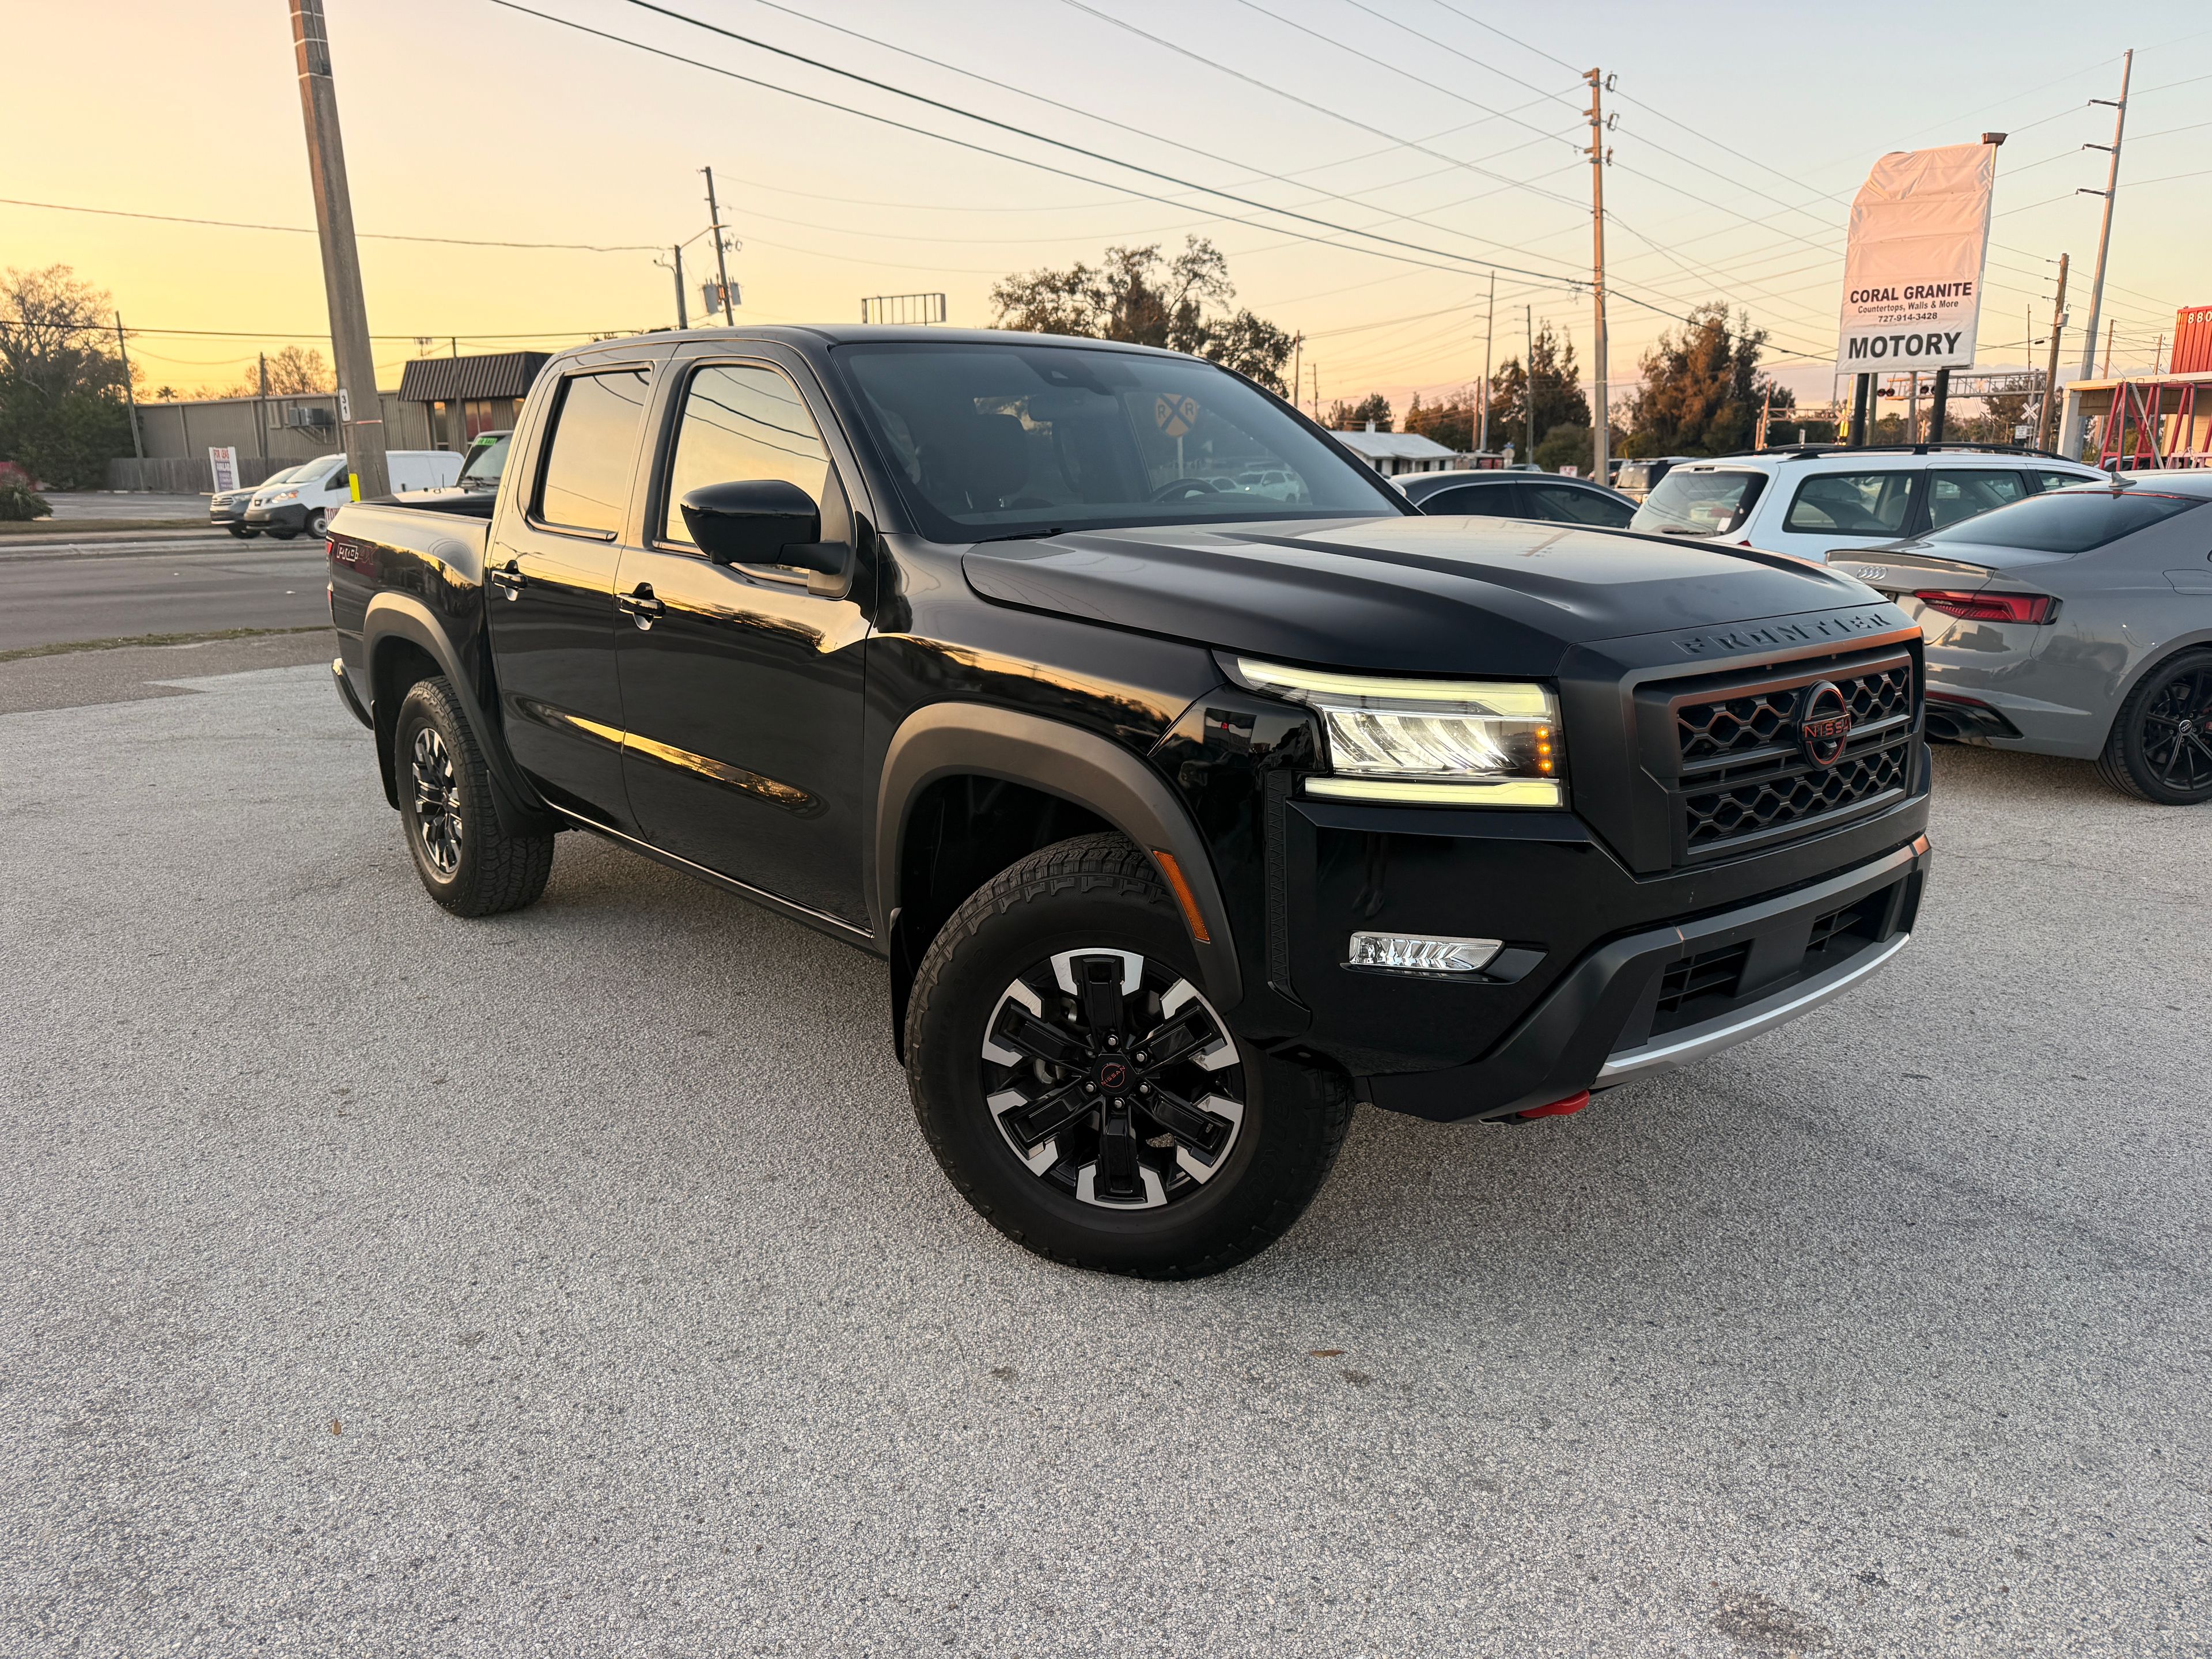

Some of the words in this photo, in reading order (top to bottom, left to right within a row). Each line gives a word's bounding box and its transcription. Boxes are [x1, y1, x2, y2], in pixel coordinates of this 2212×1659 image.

[1850, 288, 1899, 304] CORAL
[1904, 282, 1972, 300] GRANITE
[1858, 305, 1906, 313] Countertops,
[1908, 301, 1928, 310] Walls
[1939, 300, 1959, 308] More
[1878, 312, 1938, 323] 727-914-3428
[1849, 332, 1962, 359] MOTORY
[1158, 404, 1166, 418] R
[1185, 403, 1194, 416] R
[1671, 613, 1892, 655] FRONTIER
[1805, 717, 1851, 738] NISSA
[1101, 1065, 1125, 1086] NISSAN
